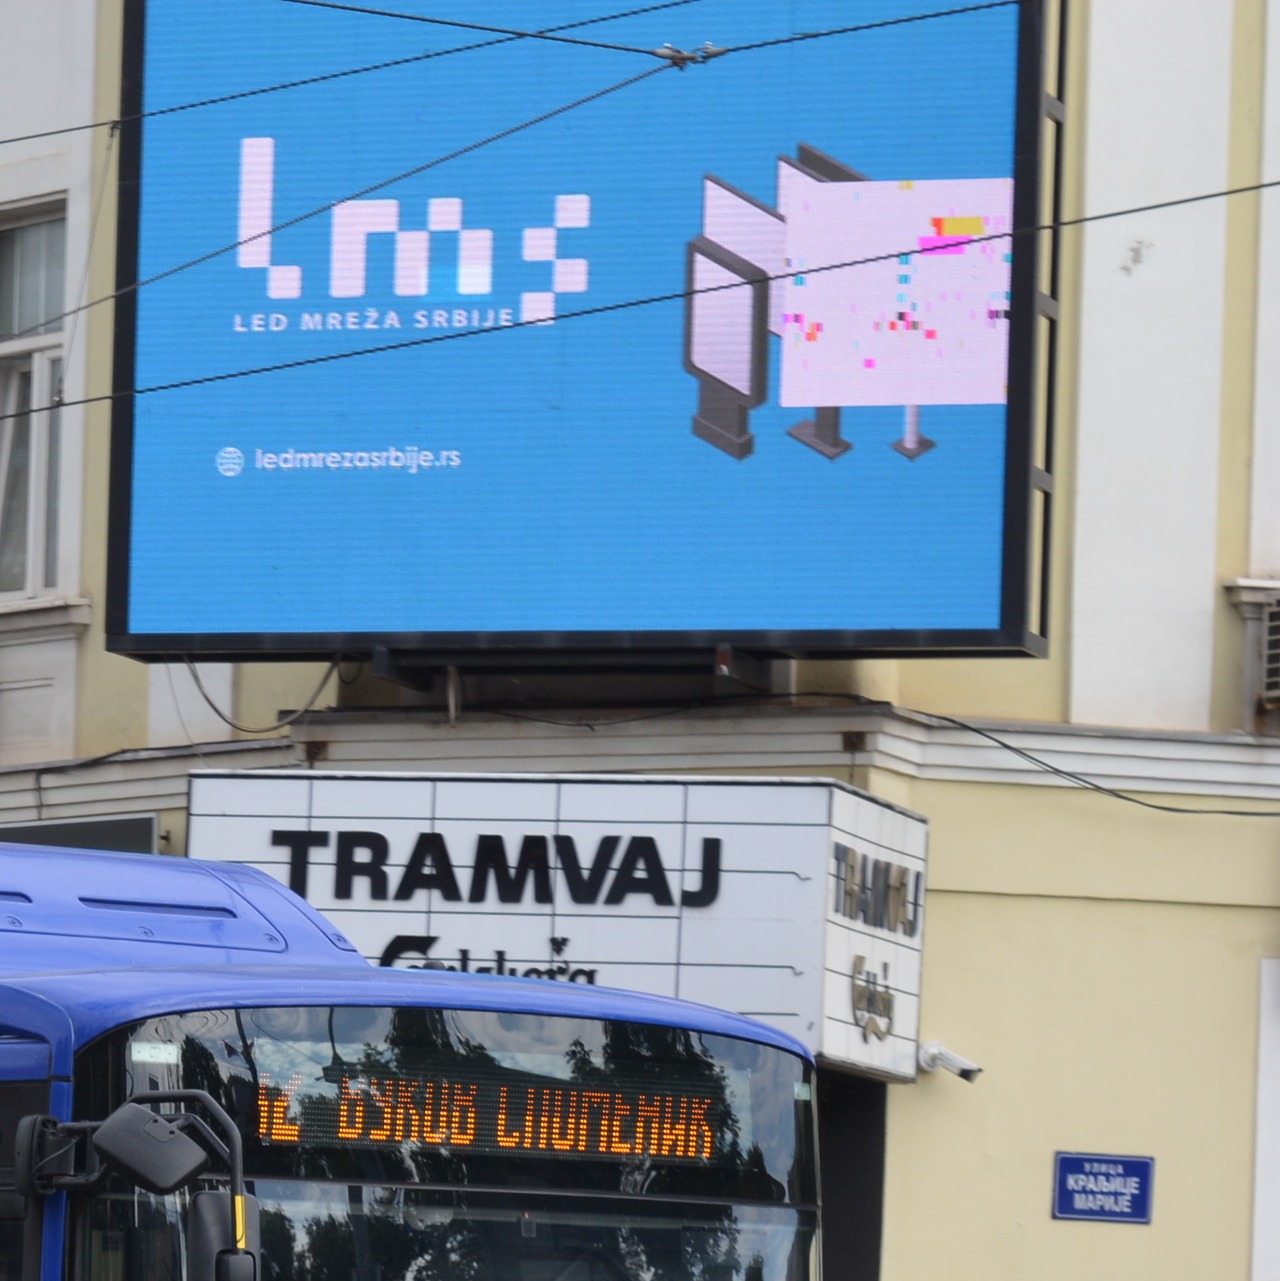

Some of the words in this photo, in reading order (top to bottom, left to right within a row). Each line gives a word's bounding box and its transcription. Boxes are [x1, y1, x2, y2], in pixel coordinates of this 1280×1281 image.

[233, 314, 289, 332] LED
[299, 308, 402, 331] MREŽA
[413, 308, 514, 329] SRBIJE
[255, 446, 462, 474] ledmrezasrbije.rs
[270, 829, 723, 908] TRAMVAJ
[833, 841, 923, 938] TRAMVAJ
[1083, 1162, 1125, 1175] УЛИЦА
[1066, 1174, 1141, 1194] КРАЉИЦЕ
[1073, 1192, 1132, 1213] МАРИЈЕ
